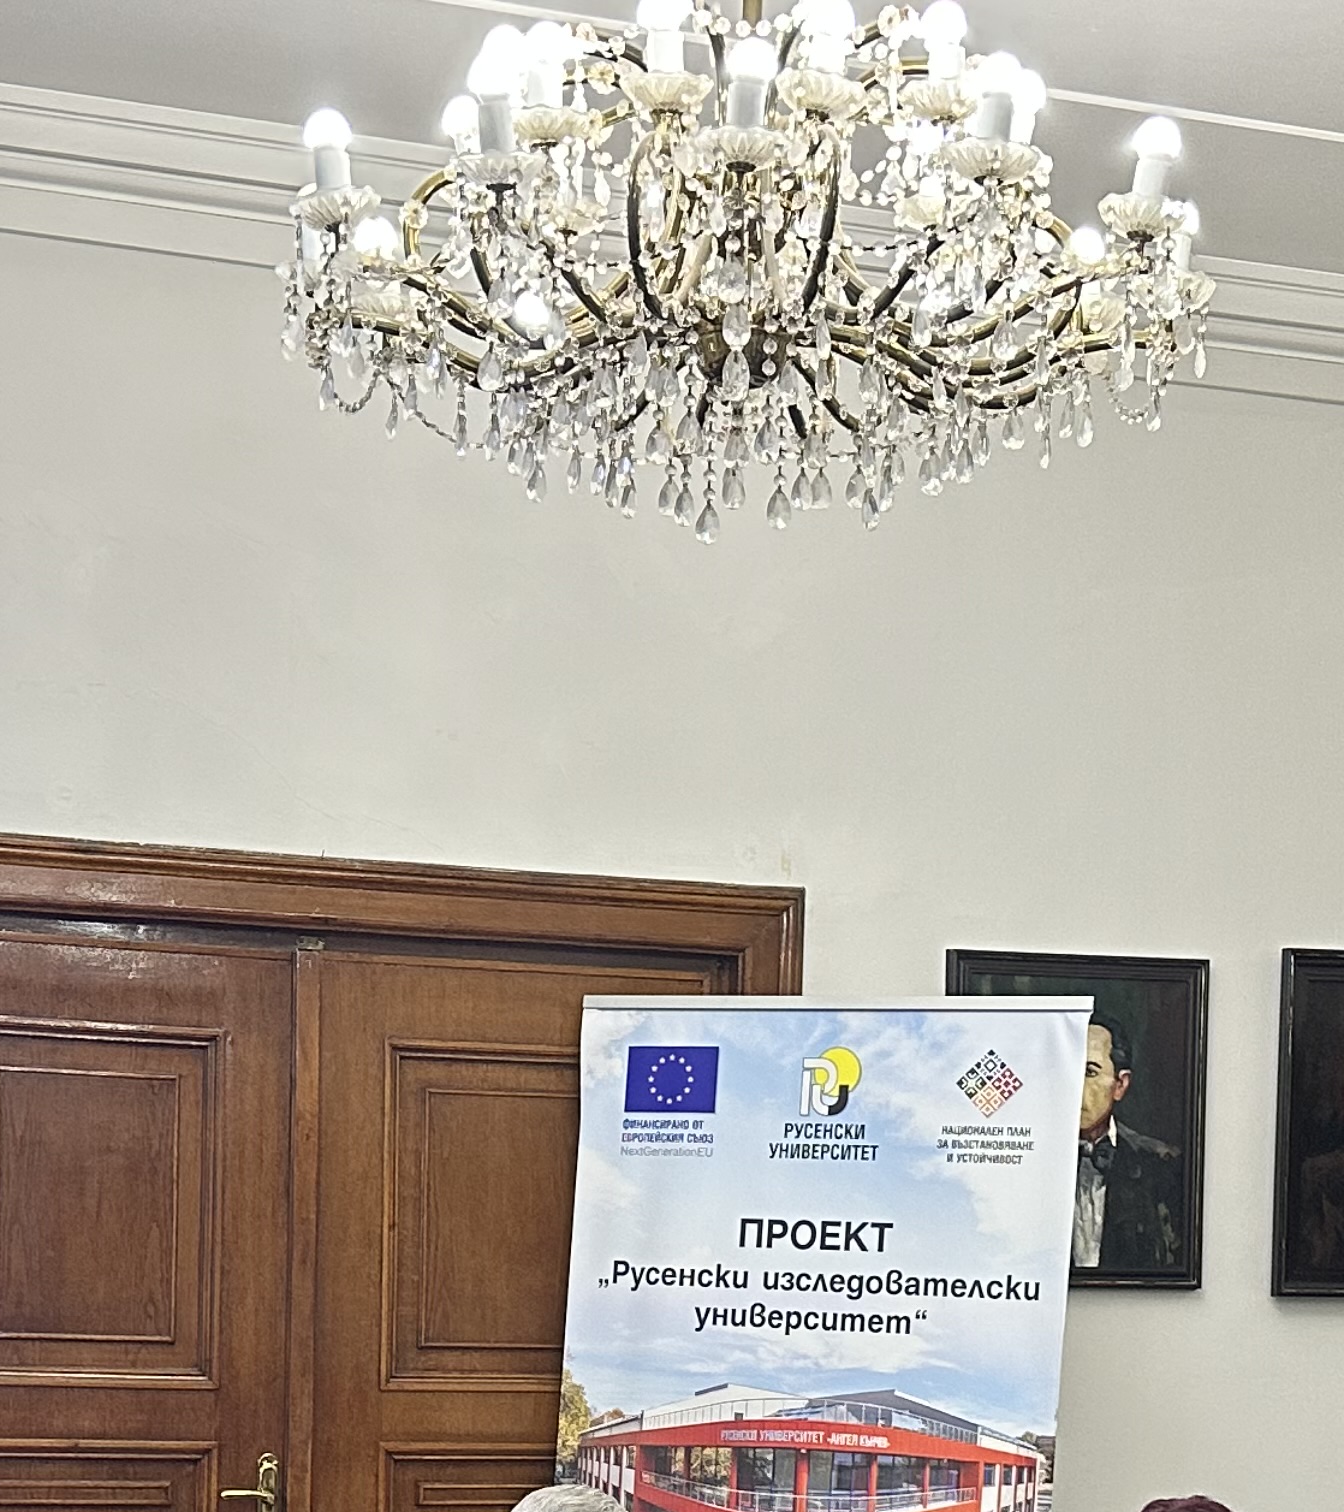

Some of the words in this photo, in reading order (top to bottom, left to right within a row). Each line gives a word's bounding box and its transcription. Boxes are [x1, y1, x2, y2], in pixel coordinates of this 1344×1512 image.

[692, 1120, 704, 1130] ОТ
[941, 1125, 1004, 1136] НАЦИОНАЛЕН
[1007, 1126, 1031, 1137] ПЛАН
[783, 1123, 866, 1140] РУСЕНСКИ
[687, 1133, 714, 1144] СЪЮЗ
[936, 1139, 949, 1149] ЗА
[769, 1143, 879, 1161] УНИВЕРСИТЕТ
[946, 1153, 954, 1162] И
[739, 1218, 894, 1252] ПРОЕКТ
[598, 1260, 749, 1291] „Русенски
[763, 1269, 1040, 1301] изследователски
